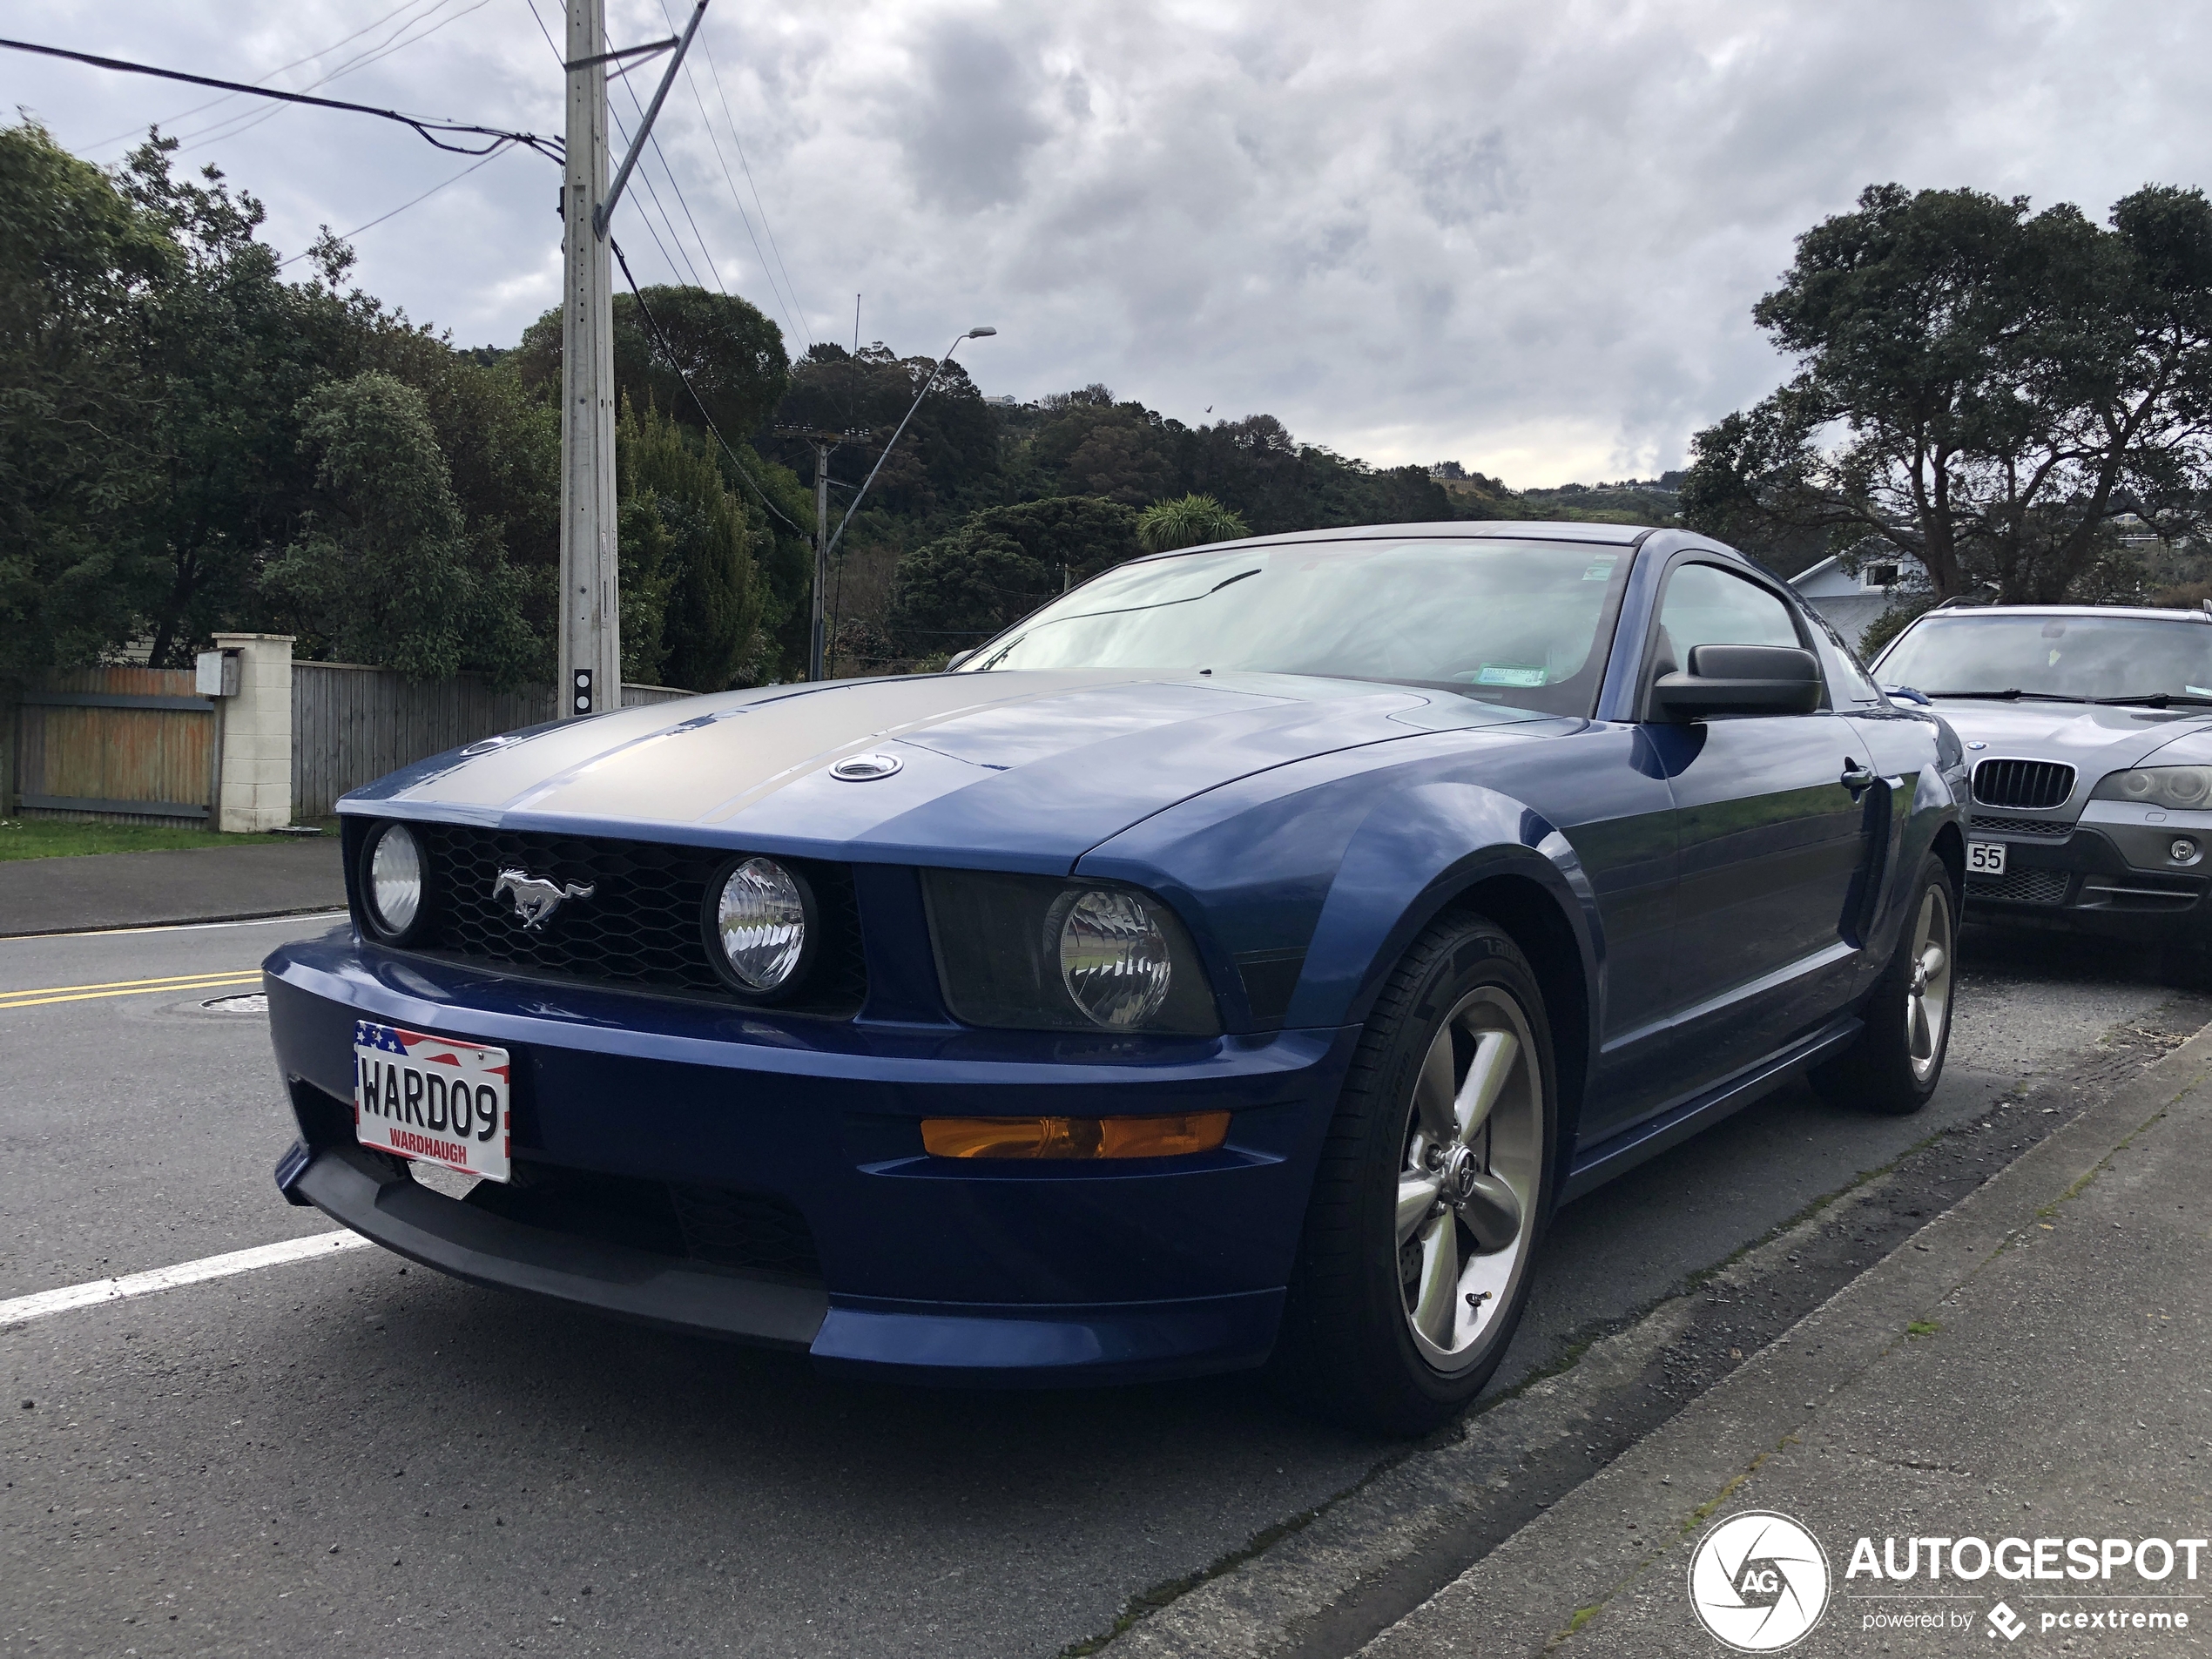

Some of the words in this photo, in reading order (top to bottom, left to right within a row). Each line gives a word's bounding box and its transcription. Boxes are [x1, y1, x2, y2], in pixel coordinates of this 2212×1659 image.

[1973, 847, 2001, 869] 55
[361, 1056, 497, 1142] WARD09
[389, 1128, 467, 1165] WARDHAUGH
